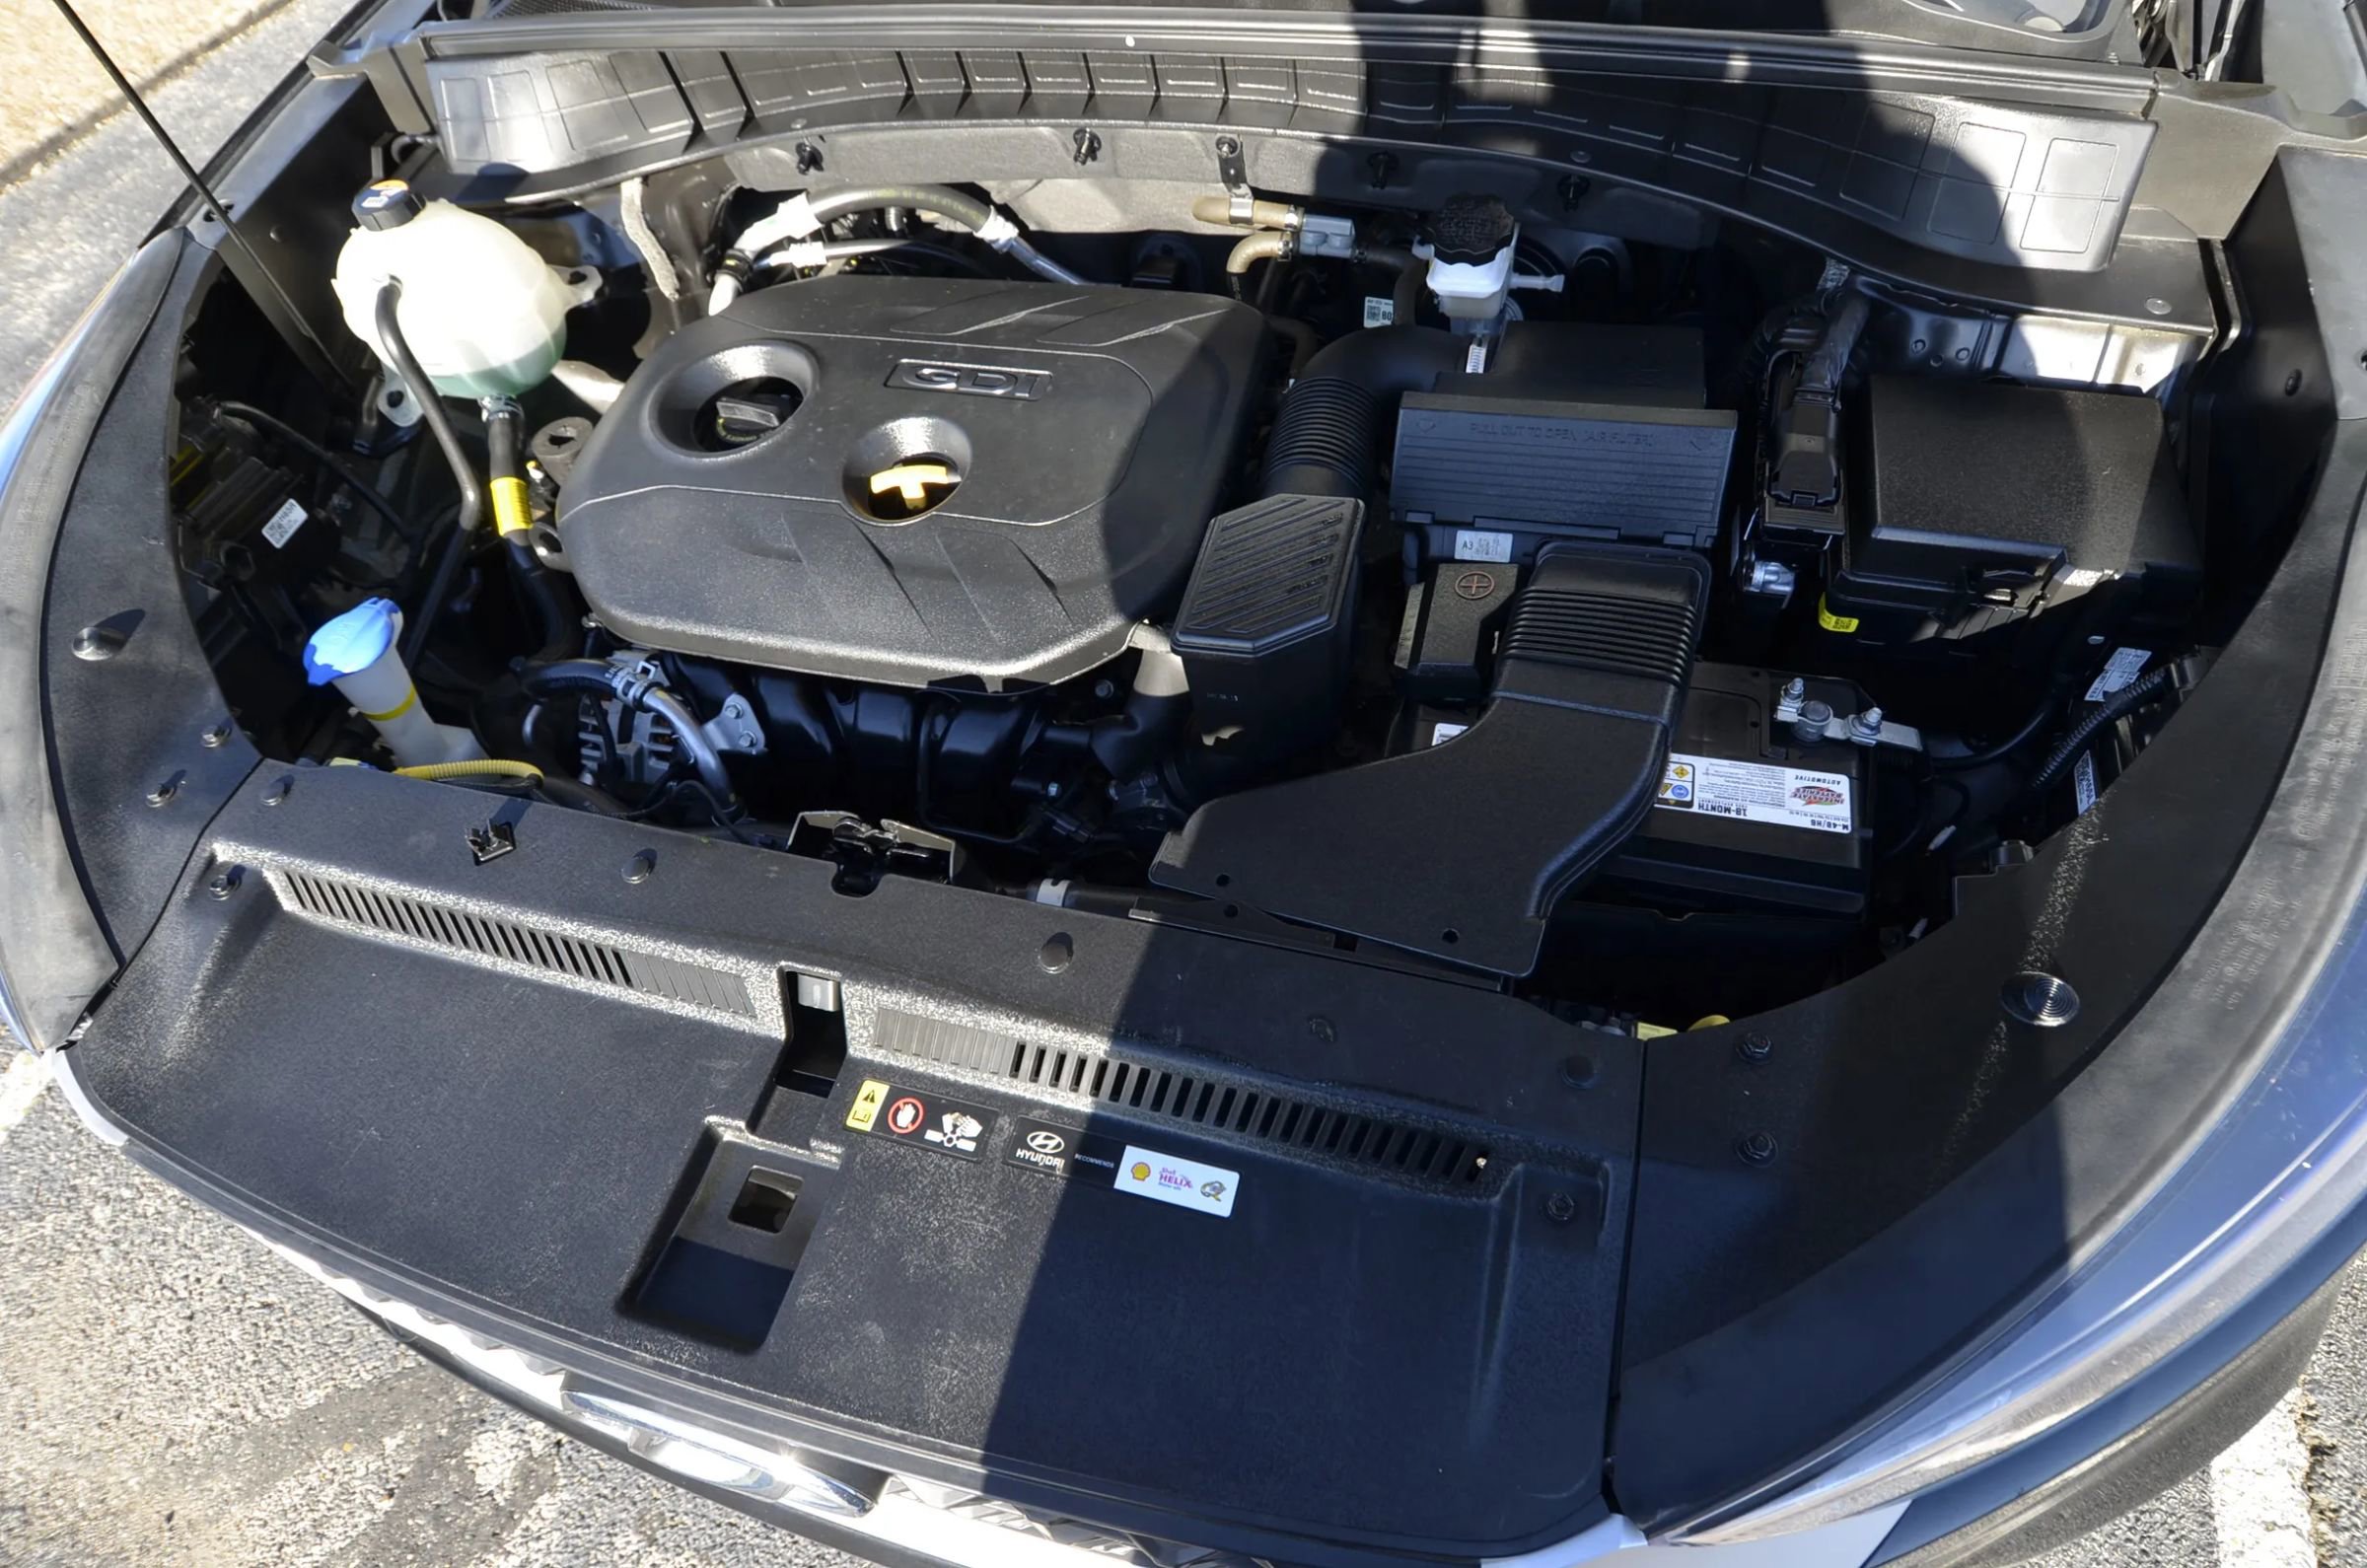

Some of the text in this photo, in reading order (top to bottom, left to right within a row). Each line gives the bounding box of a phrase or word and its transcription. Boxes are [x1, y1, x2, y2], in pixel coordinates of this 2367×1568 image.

[901, 366, 1040, 398] GDI
[1794, 774, 1841, 786] AUTOMOTIVE
[1698, 803, 1748, 818] 18-MONTH
[1016, 1148, 1065, 1169] HYUNDAI
[1159, 1173, 1192, 1189] HELIX
